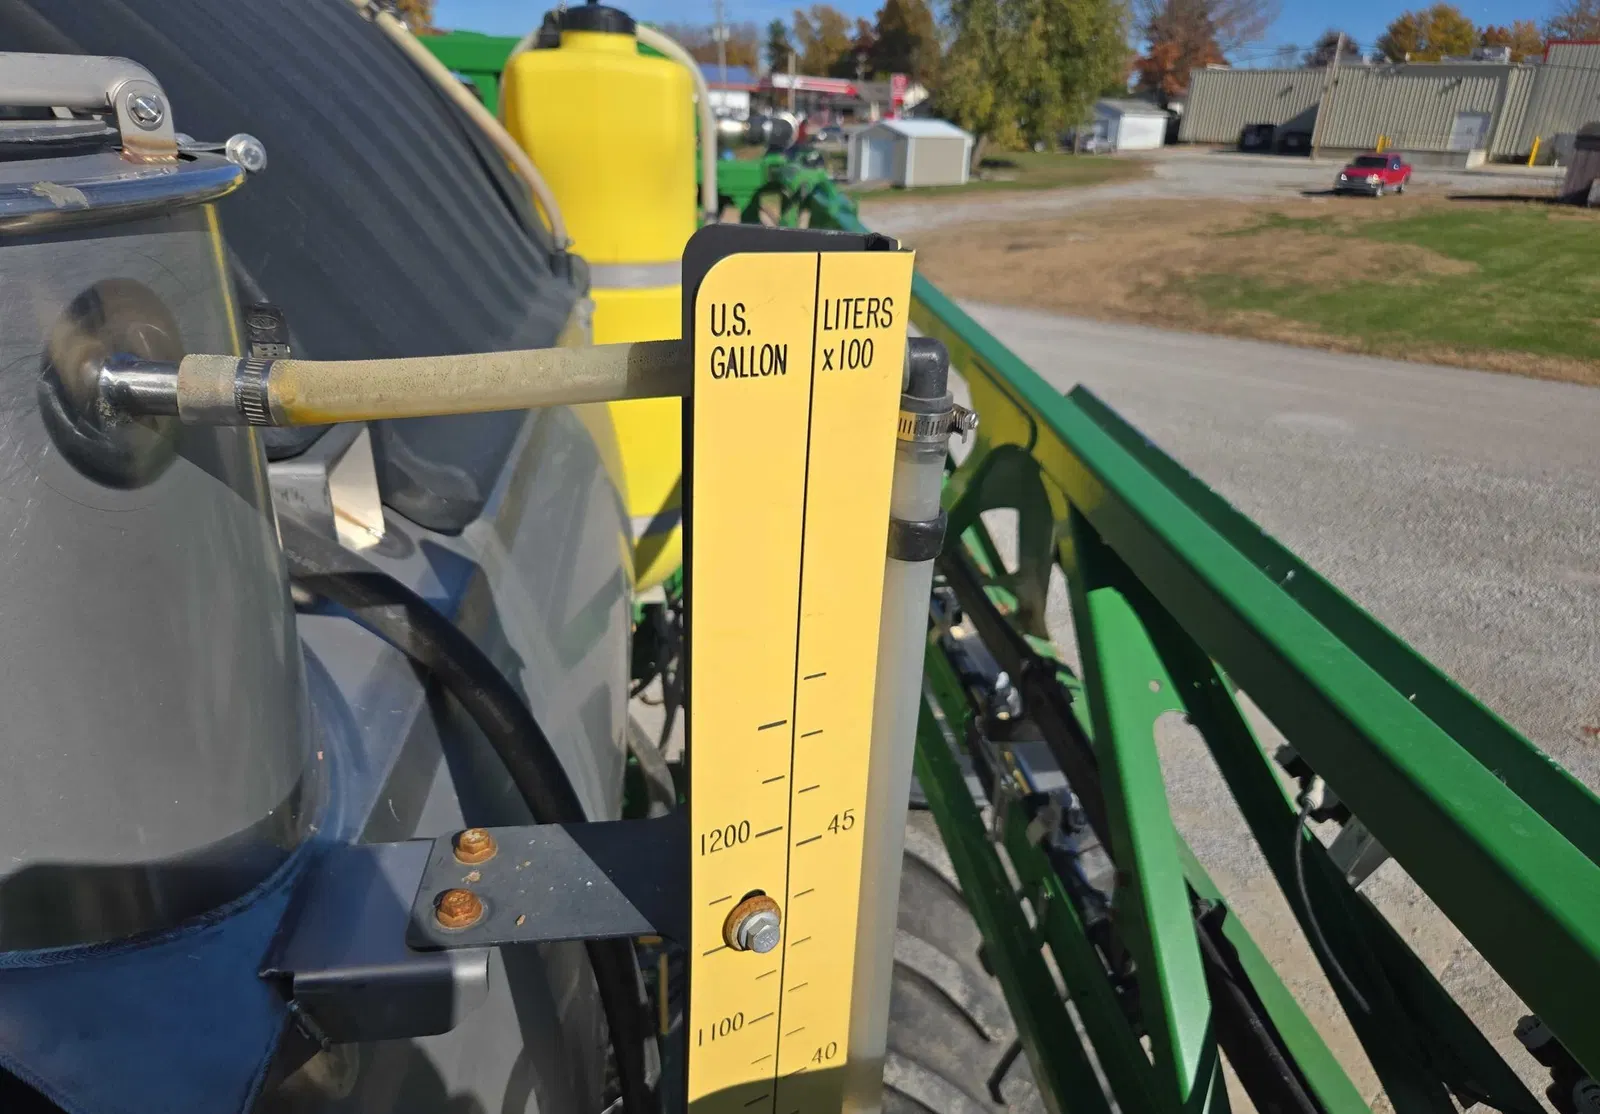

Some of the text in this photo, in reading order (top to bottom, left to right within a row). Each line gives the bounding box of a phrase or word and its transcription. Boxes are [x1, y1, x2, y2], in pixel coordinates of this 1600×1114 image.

[711, 302, 751, 337] U.S.
[823, 297, 893, 330] LITERS
[710, 343, 788, 379] GALLON
[822, 338, 874, 371] x100
[827, 808, 856, 834] 45
[701, 820, 751, 856] 1200
[698, 1012, 744, 1046] 1100
[811, 1042, 837, 1064] 40
